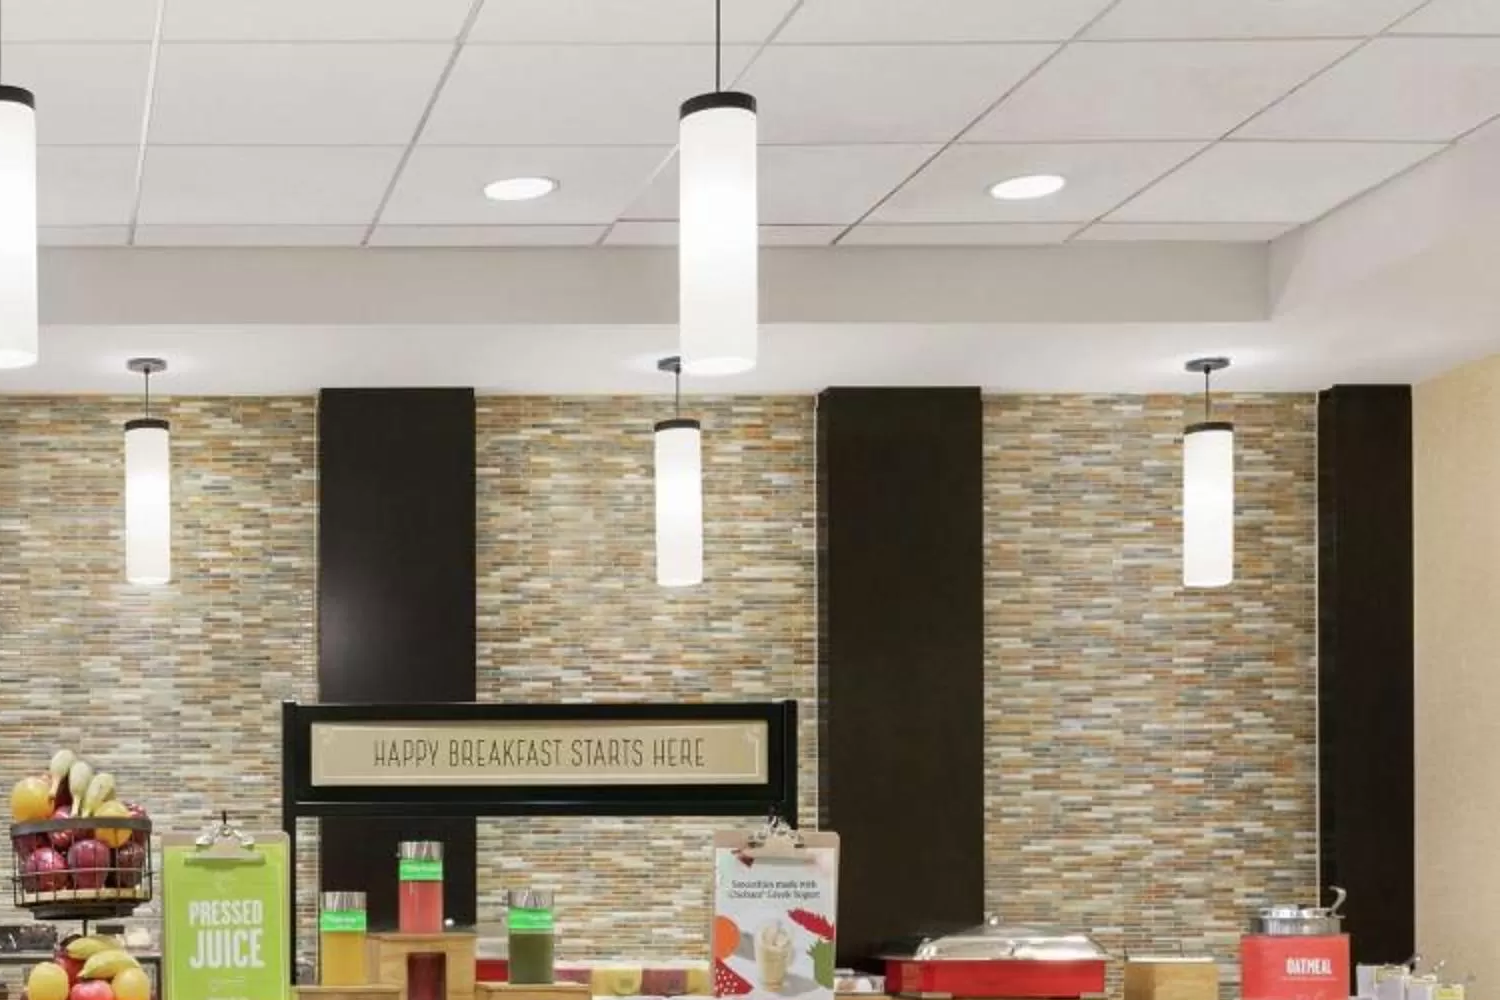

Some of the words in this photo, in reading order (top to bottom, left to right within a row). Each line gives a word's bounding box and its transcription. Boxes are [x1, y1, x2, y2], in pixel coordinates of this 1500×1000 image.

[374, 739, 439, 767] HAPPY
[449, 739, 562, 767] BREAKFAST
[571, 738, 643, 767] STARTS
[653, 738, 705, 767] HERE
[189, 900, 263, 926] PRESSED
[189, 928, 265, 969] JUICE
[1285, 958, 1333, 975] OATMEAL
